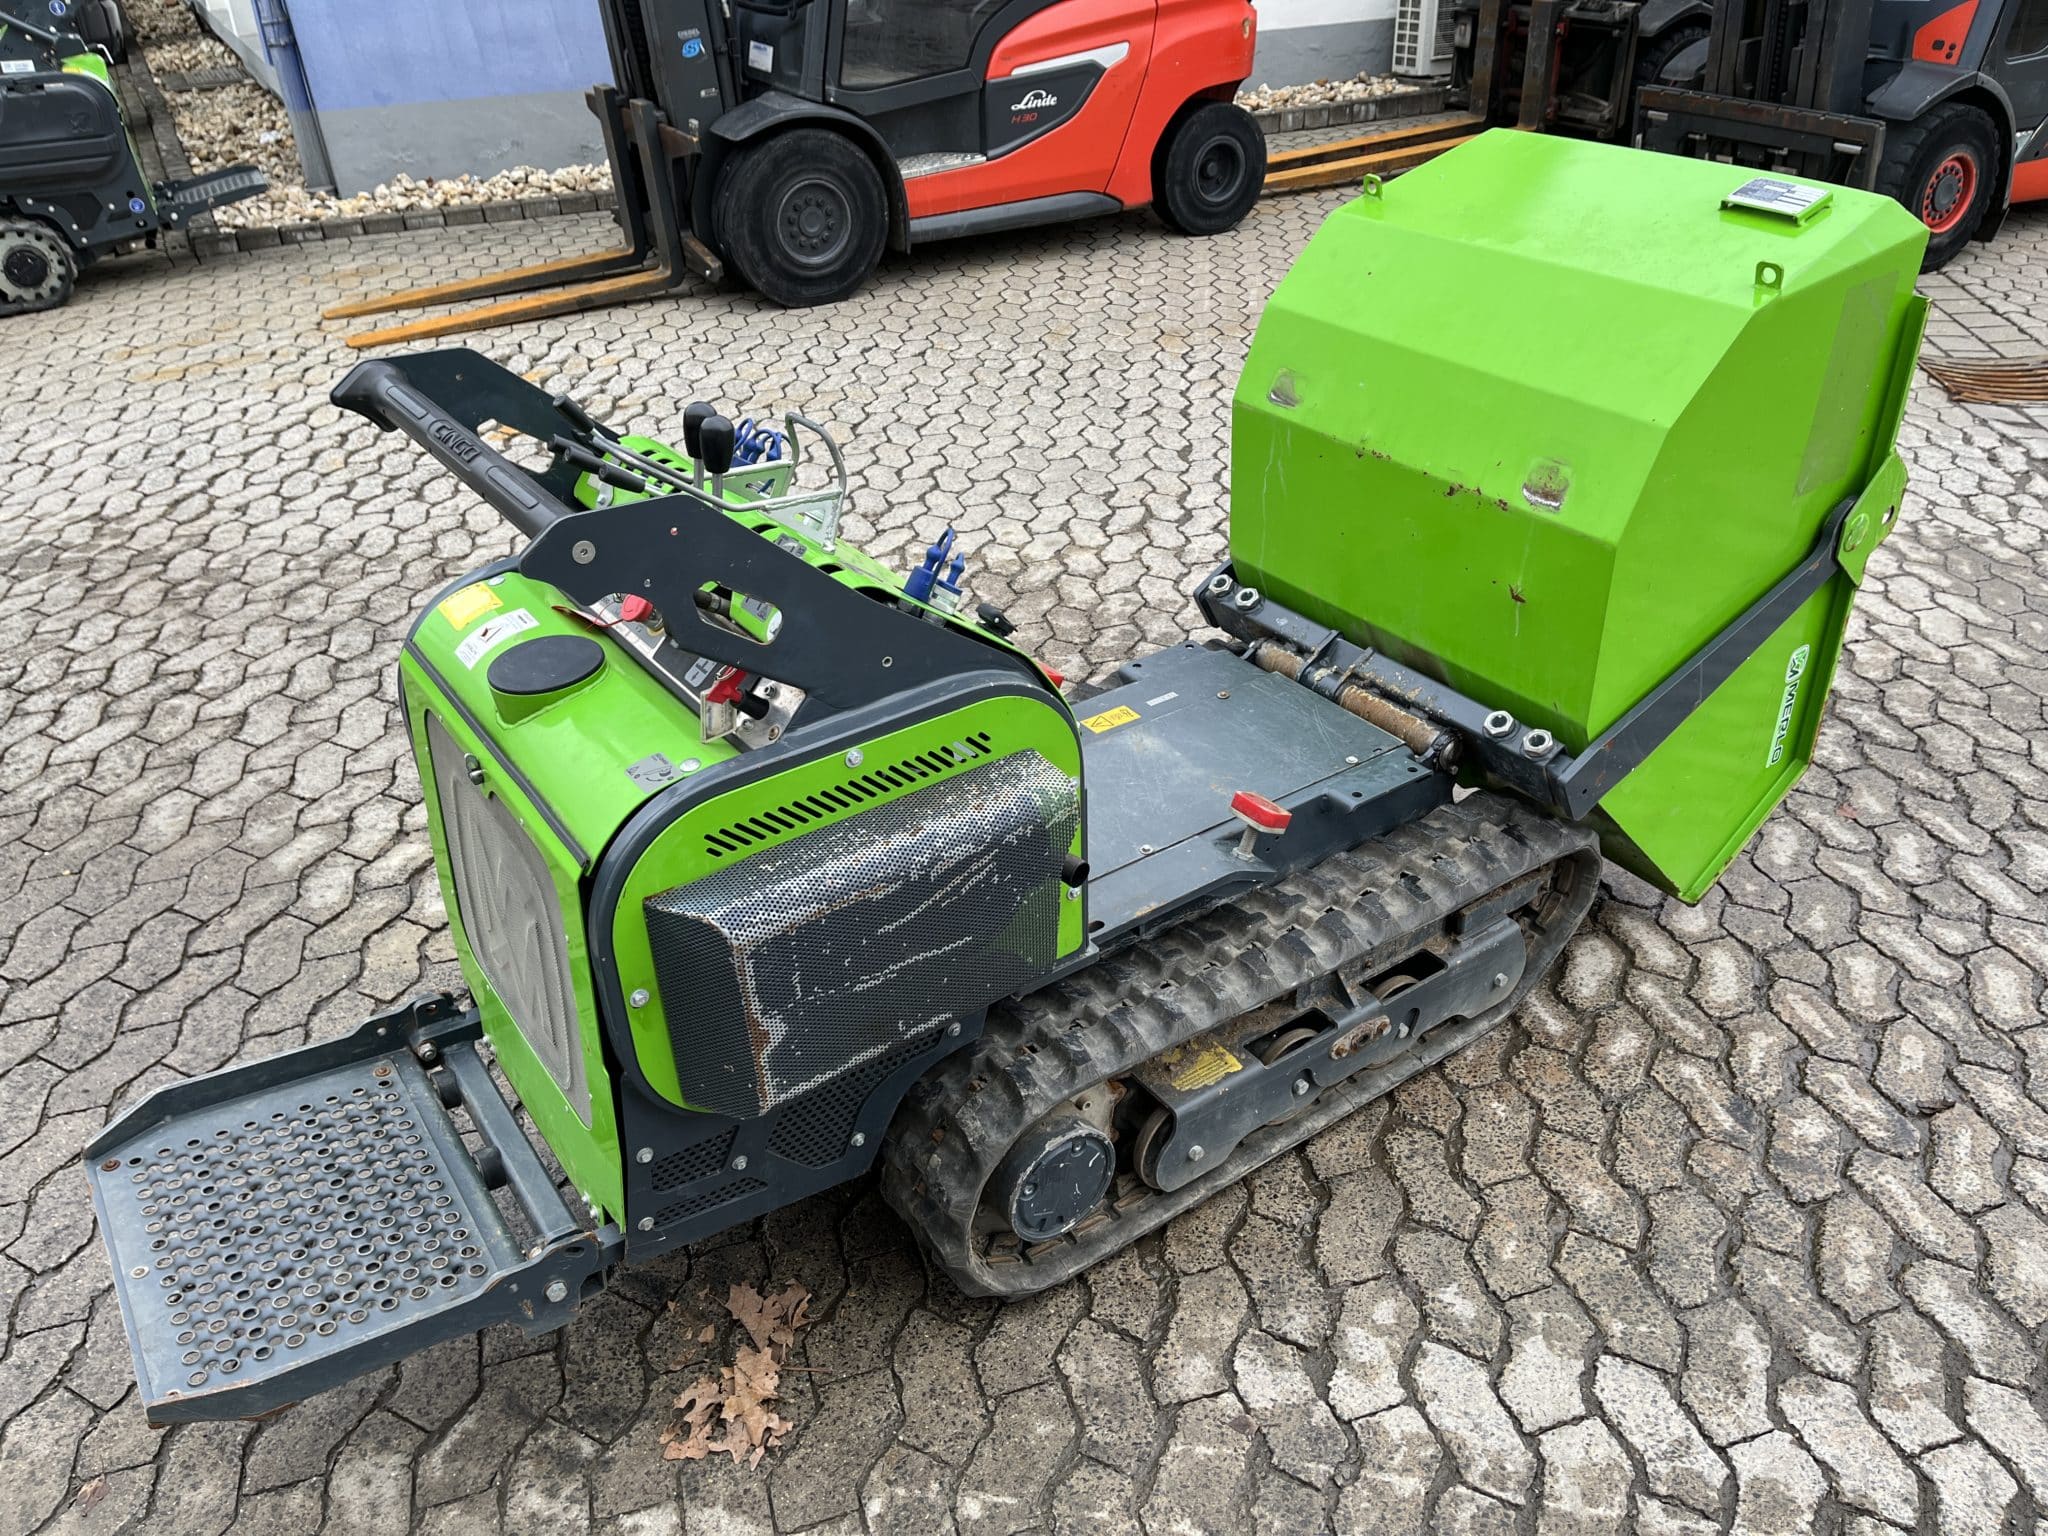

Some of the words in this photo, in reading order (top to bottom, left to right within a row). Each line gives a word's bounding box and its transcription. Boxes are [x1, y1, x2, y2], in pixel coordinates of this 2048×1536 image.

[1011, 90, 1057, 111] Linde
[1011, 115, 1021, 124] H
[1022, 112, 1038, 122] 30
[434, 424, 482, 463] CINGO
[1770, 681, 1799, 764] MERLO
